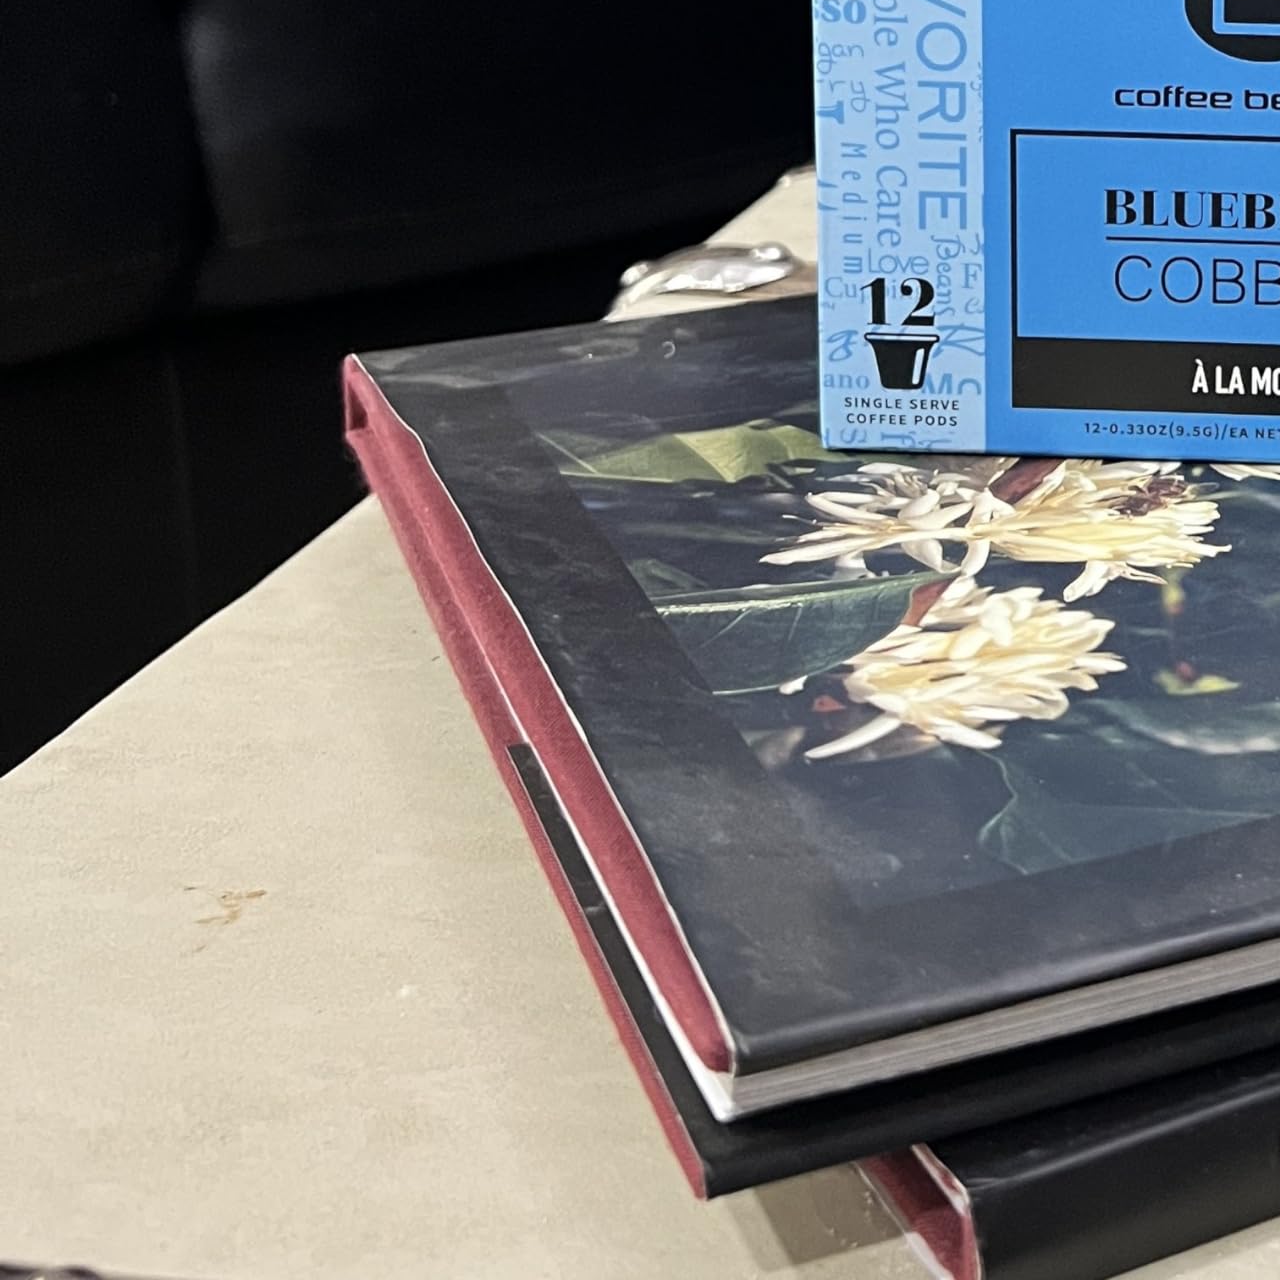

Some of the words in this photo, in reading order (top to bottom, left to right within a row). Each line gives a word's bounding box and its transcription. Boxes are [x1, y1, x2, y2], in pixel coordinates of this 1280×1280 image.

[874, 62, 911, 150] Who
[1114, 85, 1233, 109] coffee
[840, 142, 869, 274] Medium
[876, 165, 908, 248] Care
[868, 248, 930, 275] Love
[860, 278, 935, 326] 12
[1191, 358, 1209, 394] À
[1215, 365, 1245, 395] LA
[844, 397, 903, 410] SINGLE
[909, 399, 960, 411] SERVE
[846, 413, 907, 426] COFFEE
[914, 415, 958, 427] PODS
